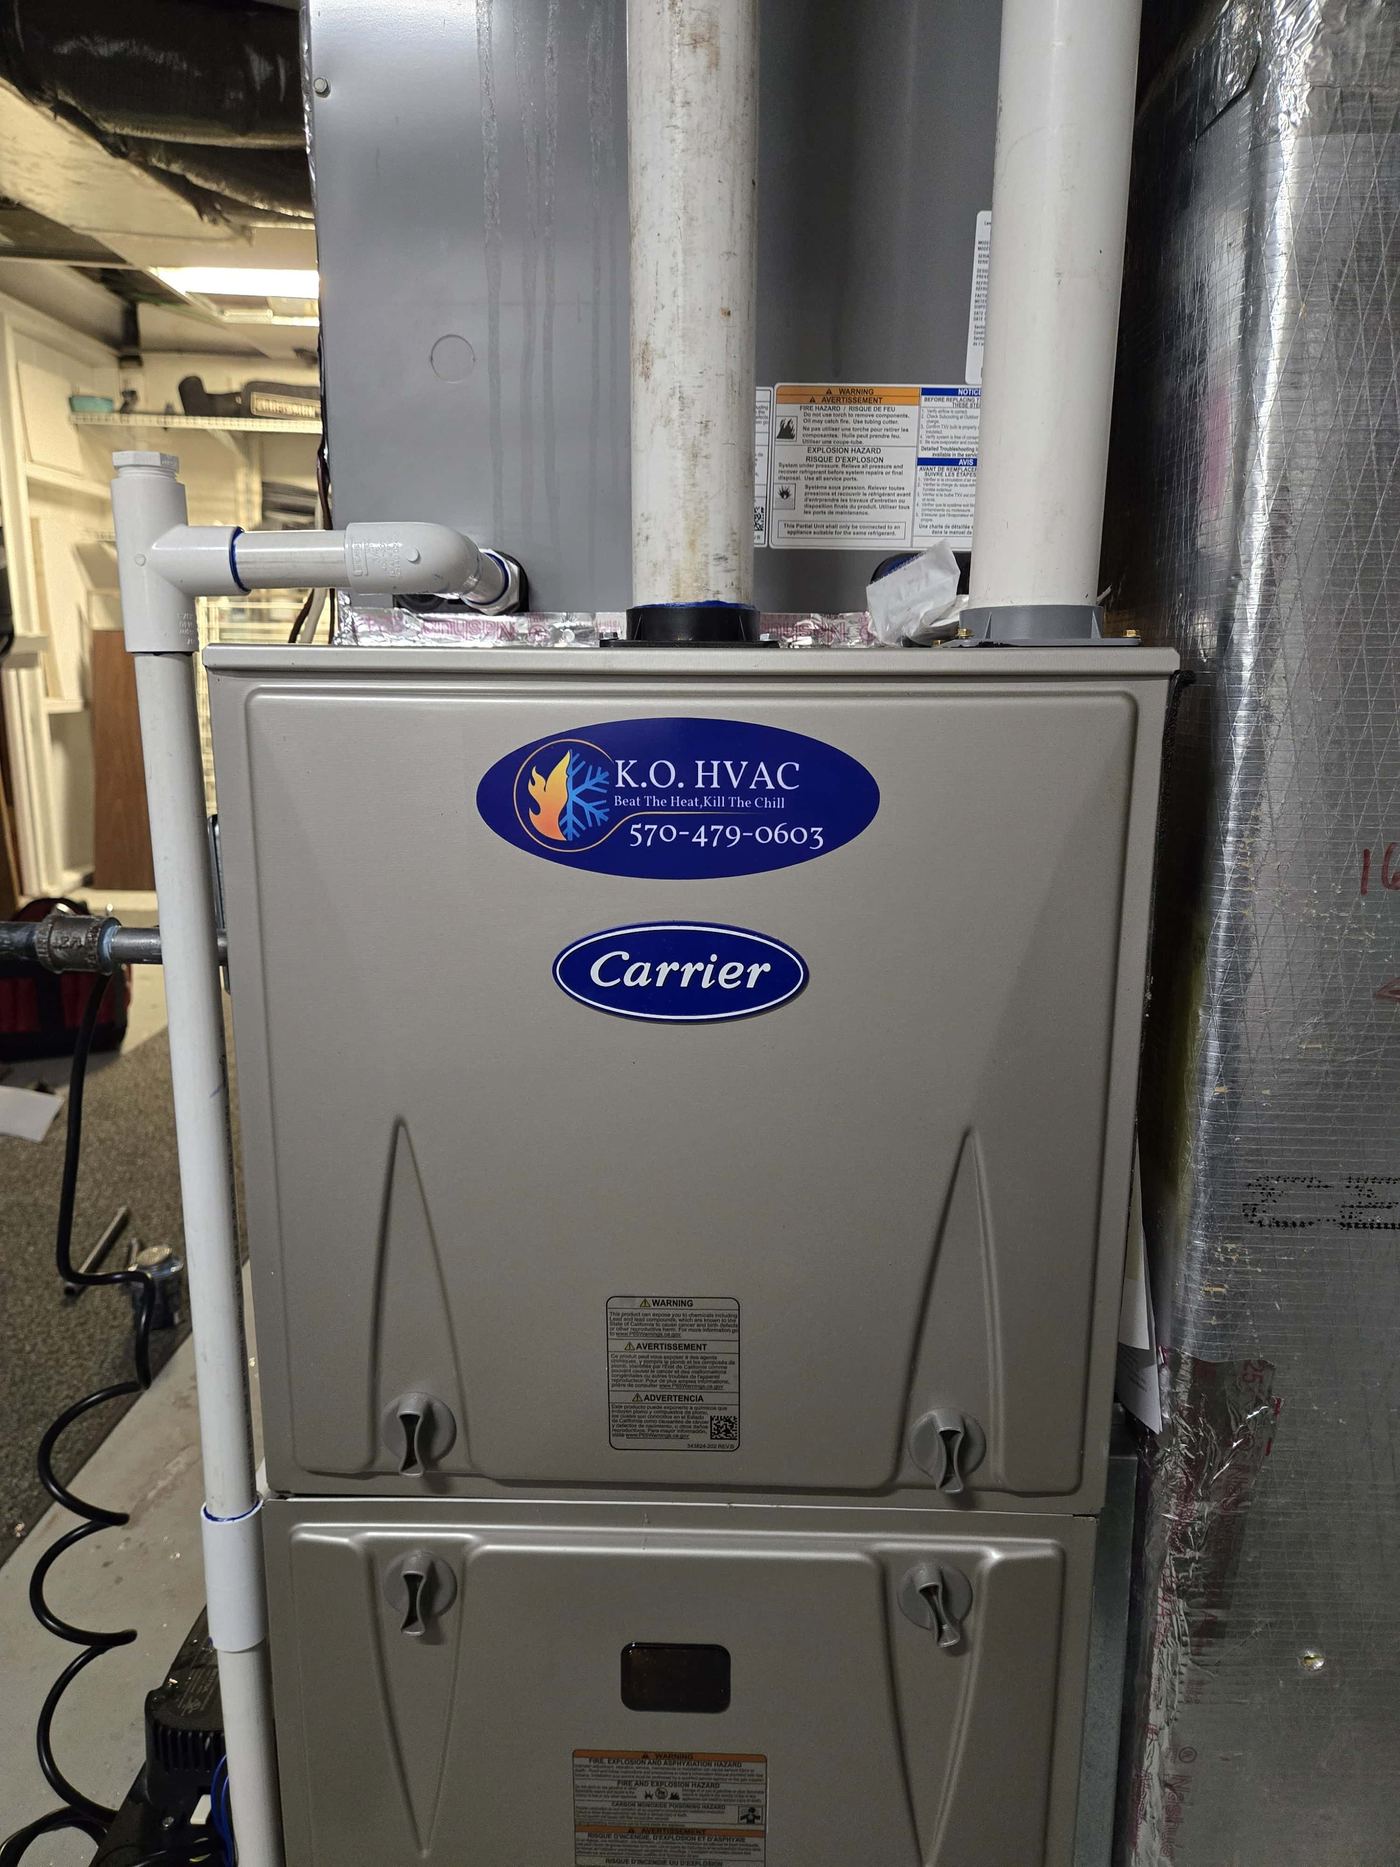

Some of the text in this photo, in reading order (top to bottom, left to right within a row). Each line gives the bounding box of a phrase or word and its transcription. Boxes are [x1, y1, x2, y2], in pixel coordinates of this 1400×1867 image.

[615, 759, 800, 790] K.O. HVAC
[614, 796, 785, 809] Beat The Heat,Kill The Chill
[630, 822, 824, 850] 570-479-0603
[590, 950, 771, 989] Carrier
[1161, 1776, 1193, 1857] Nashua
